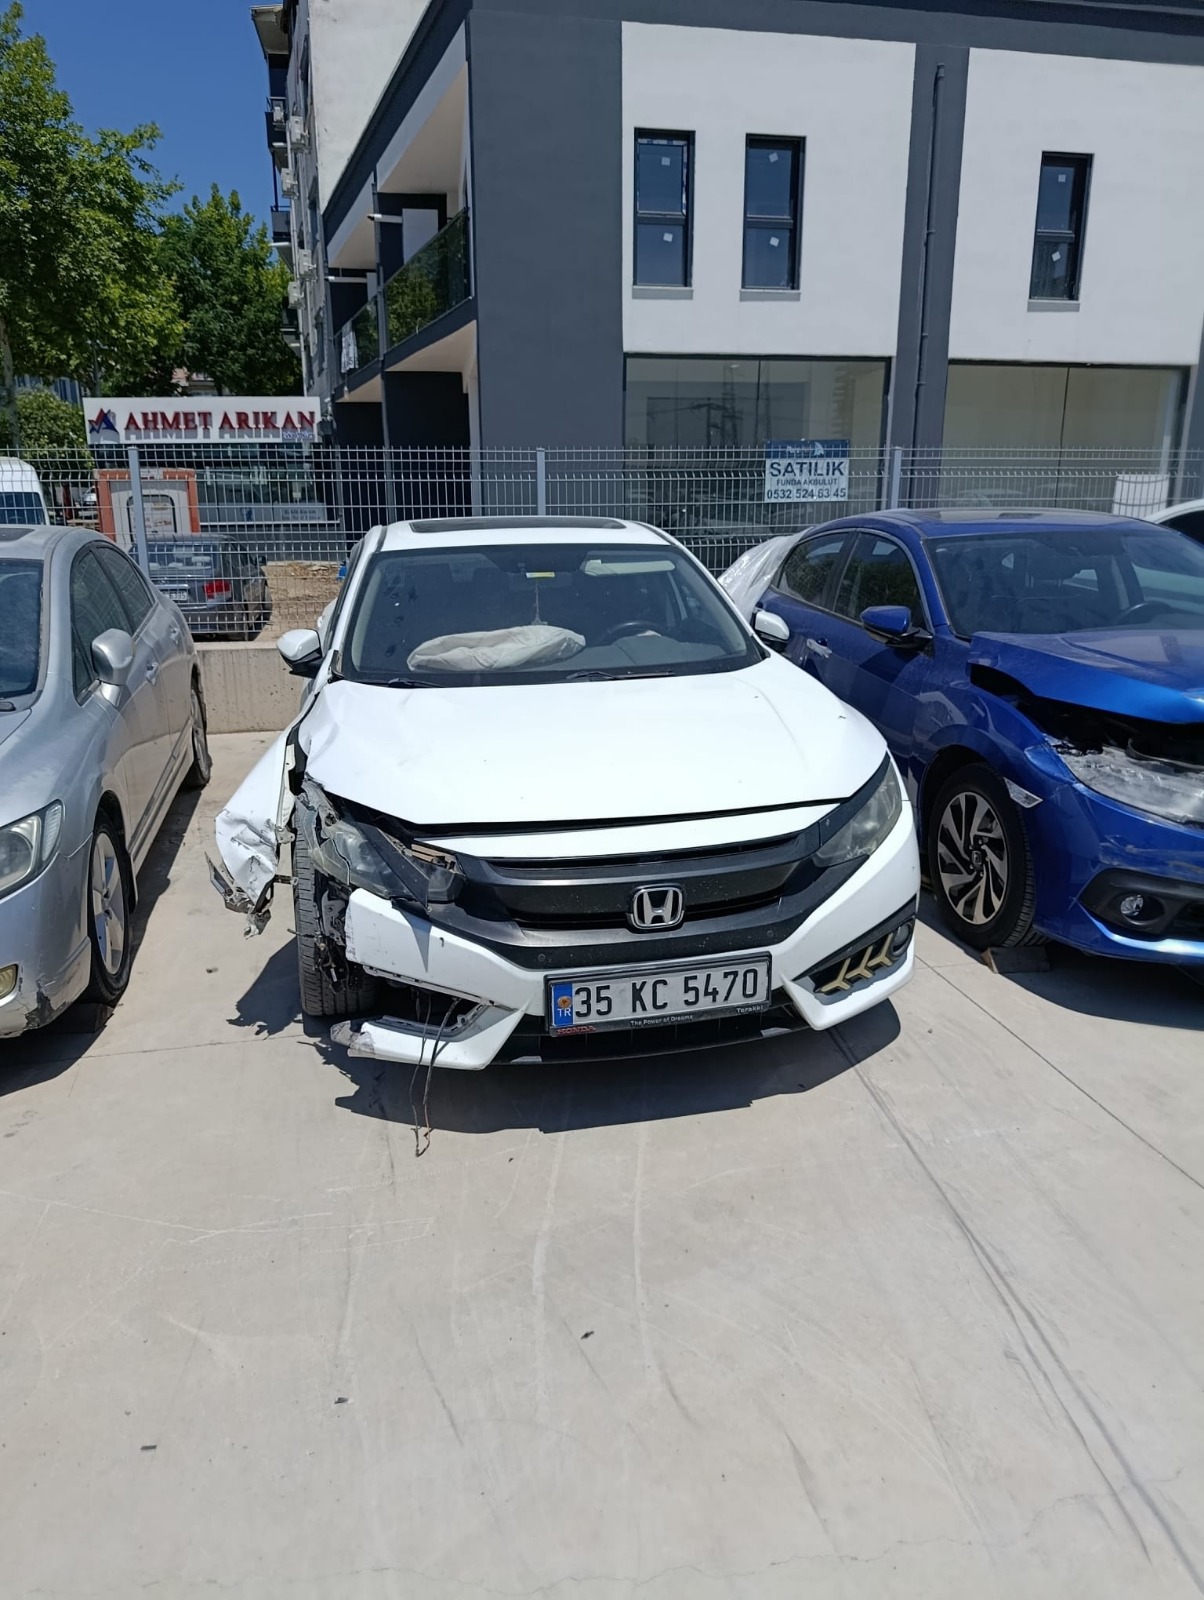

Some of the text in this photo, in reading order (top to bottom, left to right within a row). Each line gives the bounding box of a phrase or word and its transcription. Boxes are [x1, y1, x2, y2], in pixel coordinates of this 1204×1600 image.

[125, 411, 315, 430] AHMET ARIKAN
[770, 461, 844, 477] SATILIK
[803, 478, 837, 486] AKBULUT
[767, 487, 846, 499] 0532 524 63 45
[574, 968, 759, 1017] 35 KC 5470
[557, 1007, 571, 1017] TR
[643, 1017, 661, 1026] Power
[671, 1014, 694, 1022] Dreams
[556, 1025, 597, 1035] HONDA
